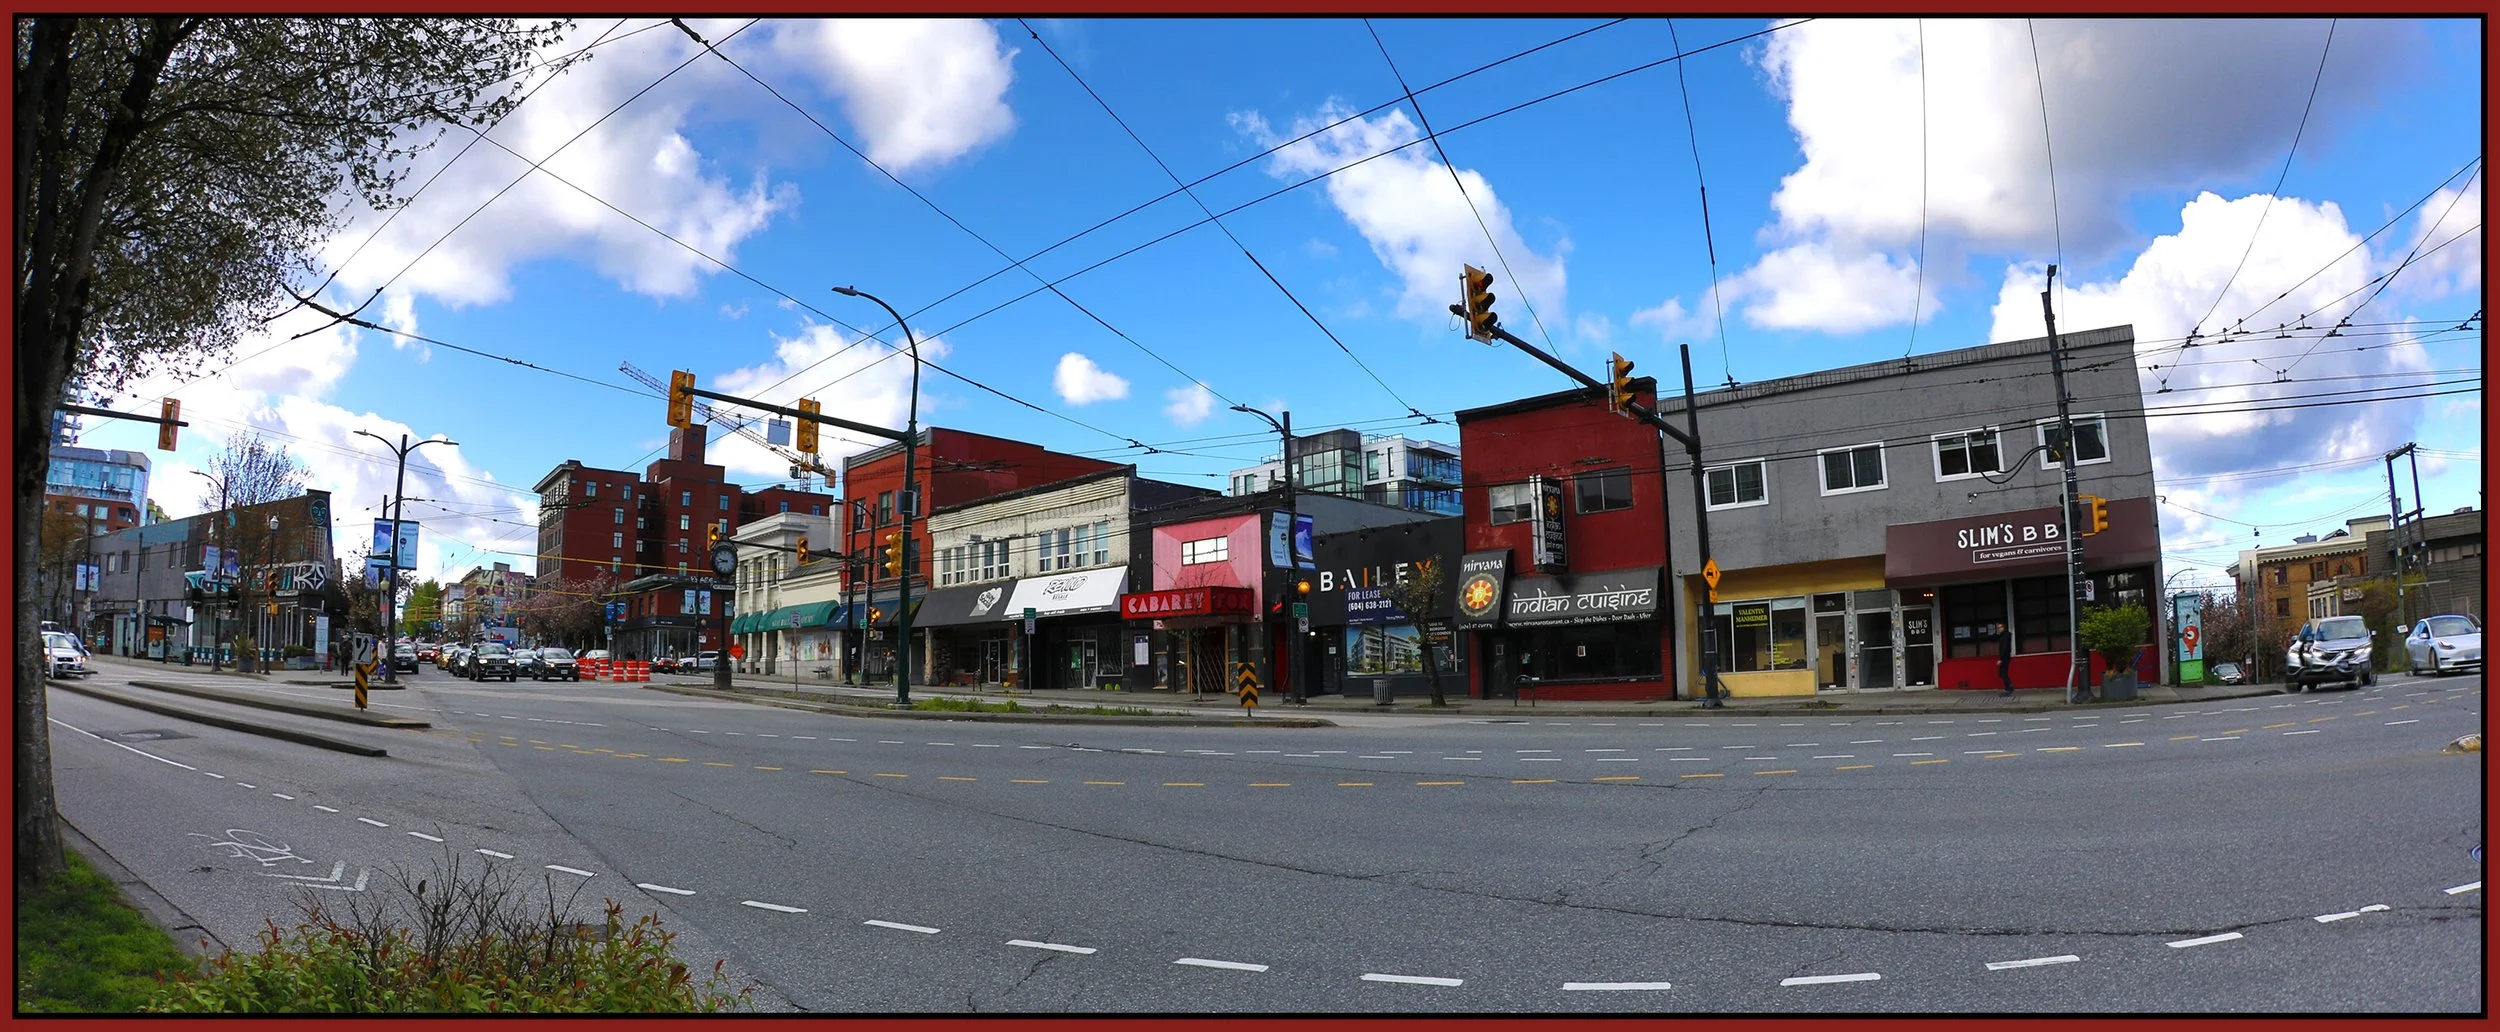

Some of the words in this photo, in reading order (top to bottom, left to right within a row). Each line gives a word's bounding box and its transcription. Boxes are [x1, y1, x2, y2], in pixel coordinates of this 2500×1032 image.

[1958, 524, 2014, 549] SLIM'S
[1992, 550, 2016, 558] vegans
[2024, 545, 2062, 554] carnivores
[1463, 560, 1503, 572] nirvana
[1320, 560, 1432, 592] BAILEY
[1216, 592, 1250, 610] FOX
[1348, 591, 1360, 601] FOR
[1362, 590, 1380, 600] LEASE
[1512, 587, 1571, 614] indian
[1577, 584, 1652, 610] cuisine
[1128, 592, 1204, 613] CABARET
[1348, 602, 1364, 612] (604)
[1365, 599, 1392, 610] 638-2121
[1739, 608, 1764, 616] VALENTIN
[1908, 619, 1928, 629] SLIM'S
